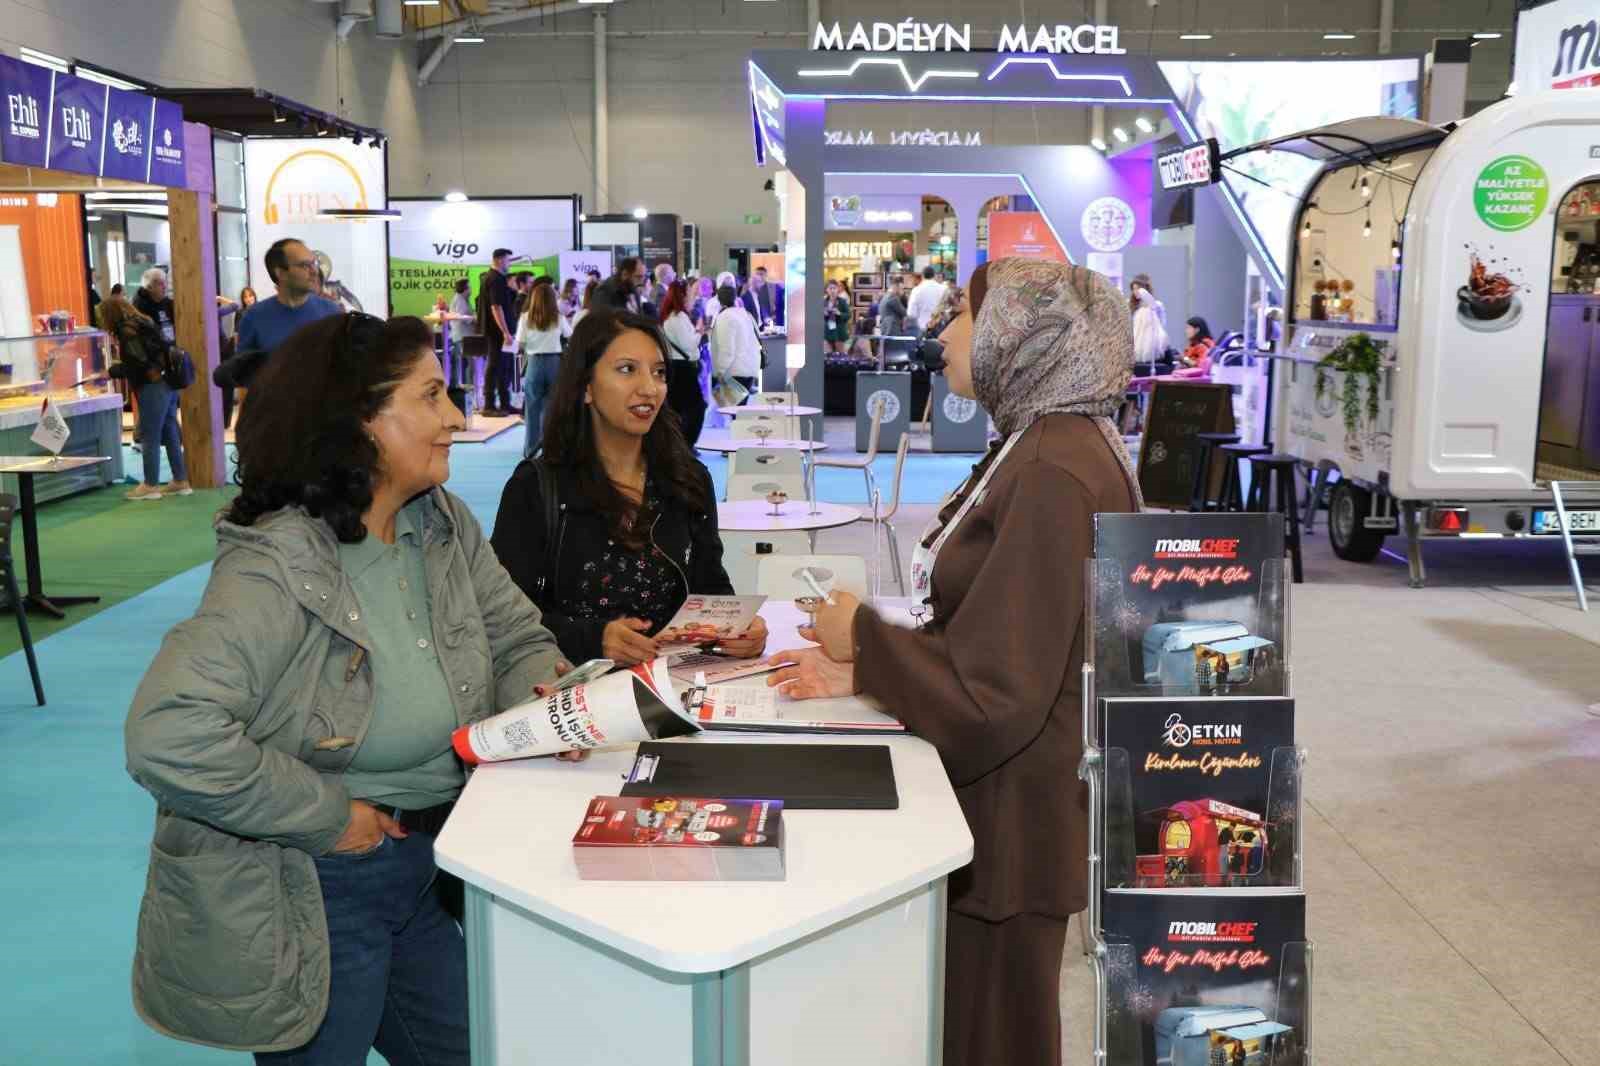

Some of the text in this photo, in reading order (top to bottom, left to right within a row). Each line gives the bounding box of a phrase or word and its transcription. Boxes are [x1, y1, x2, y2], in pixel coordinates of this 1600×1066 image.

[812, 17, 1127, 54] MADÉLYN MARCEL
[8, 93, 39, 127] Ehli
[62, 106, 91, 141] Ehli
[1504, 166, 1521, 175] AZ
[1488, 189, 1536, 200] YÜKSEK
[1484, 204, 1536, 216] KAZANÇ
[432, 240, 479, 258] vigo
